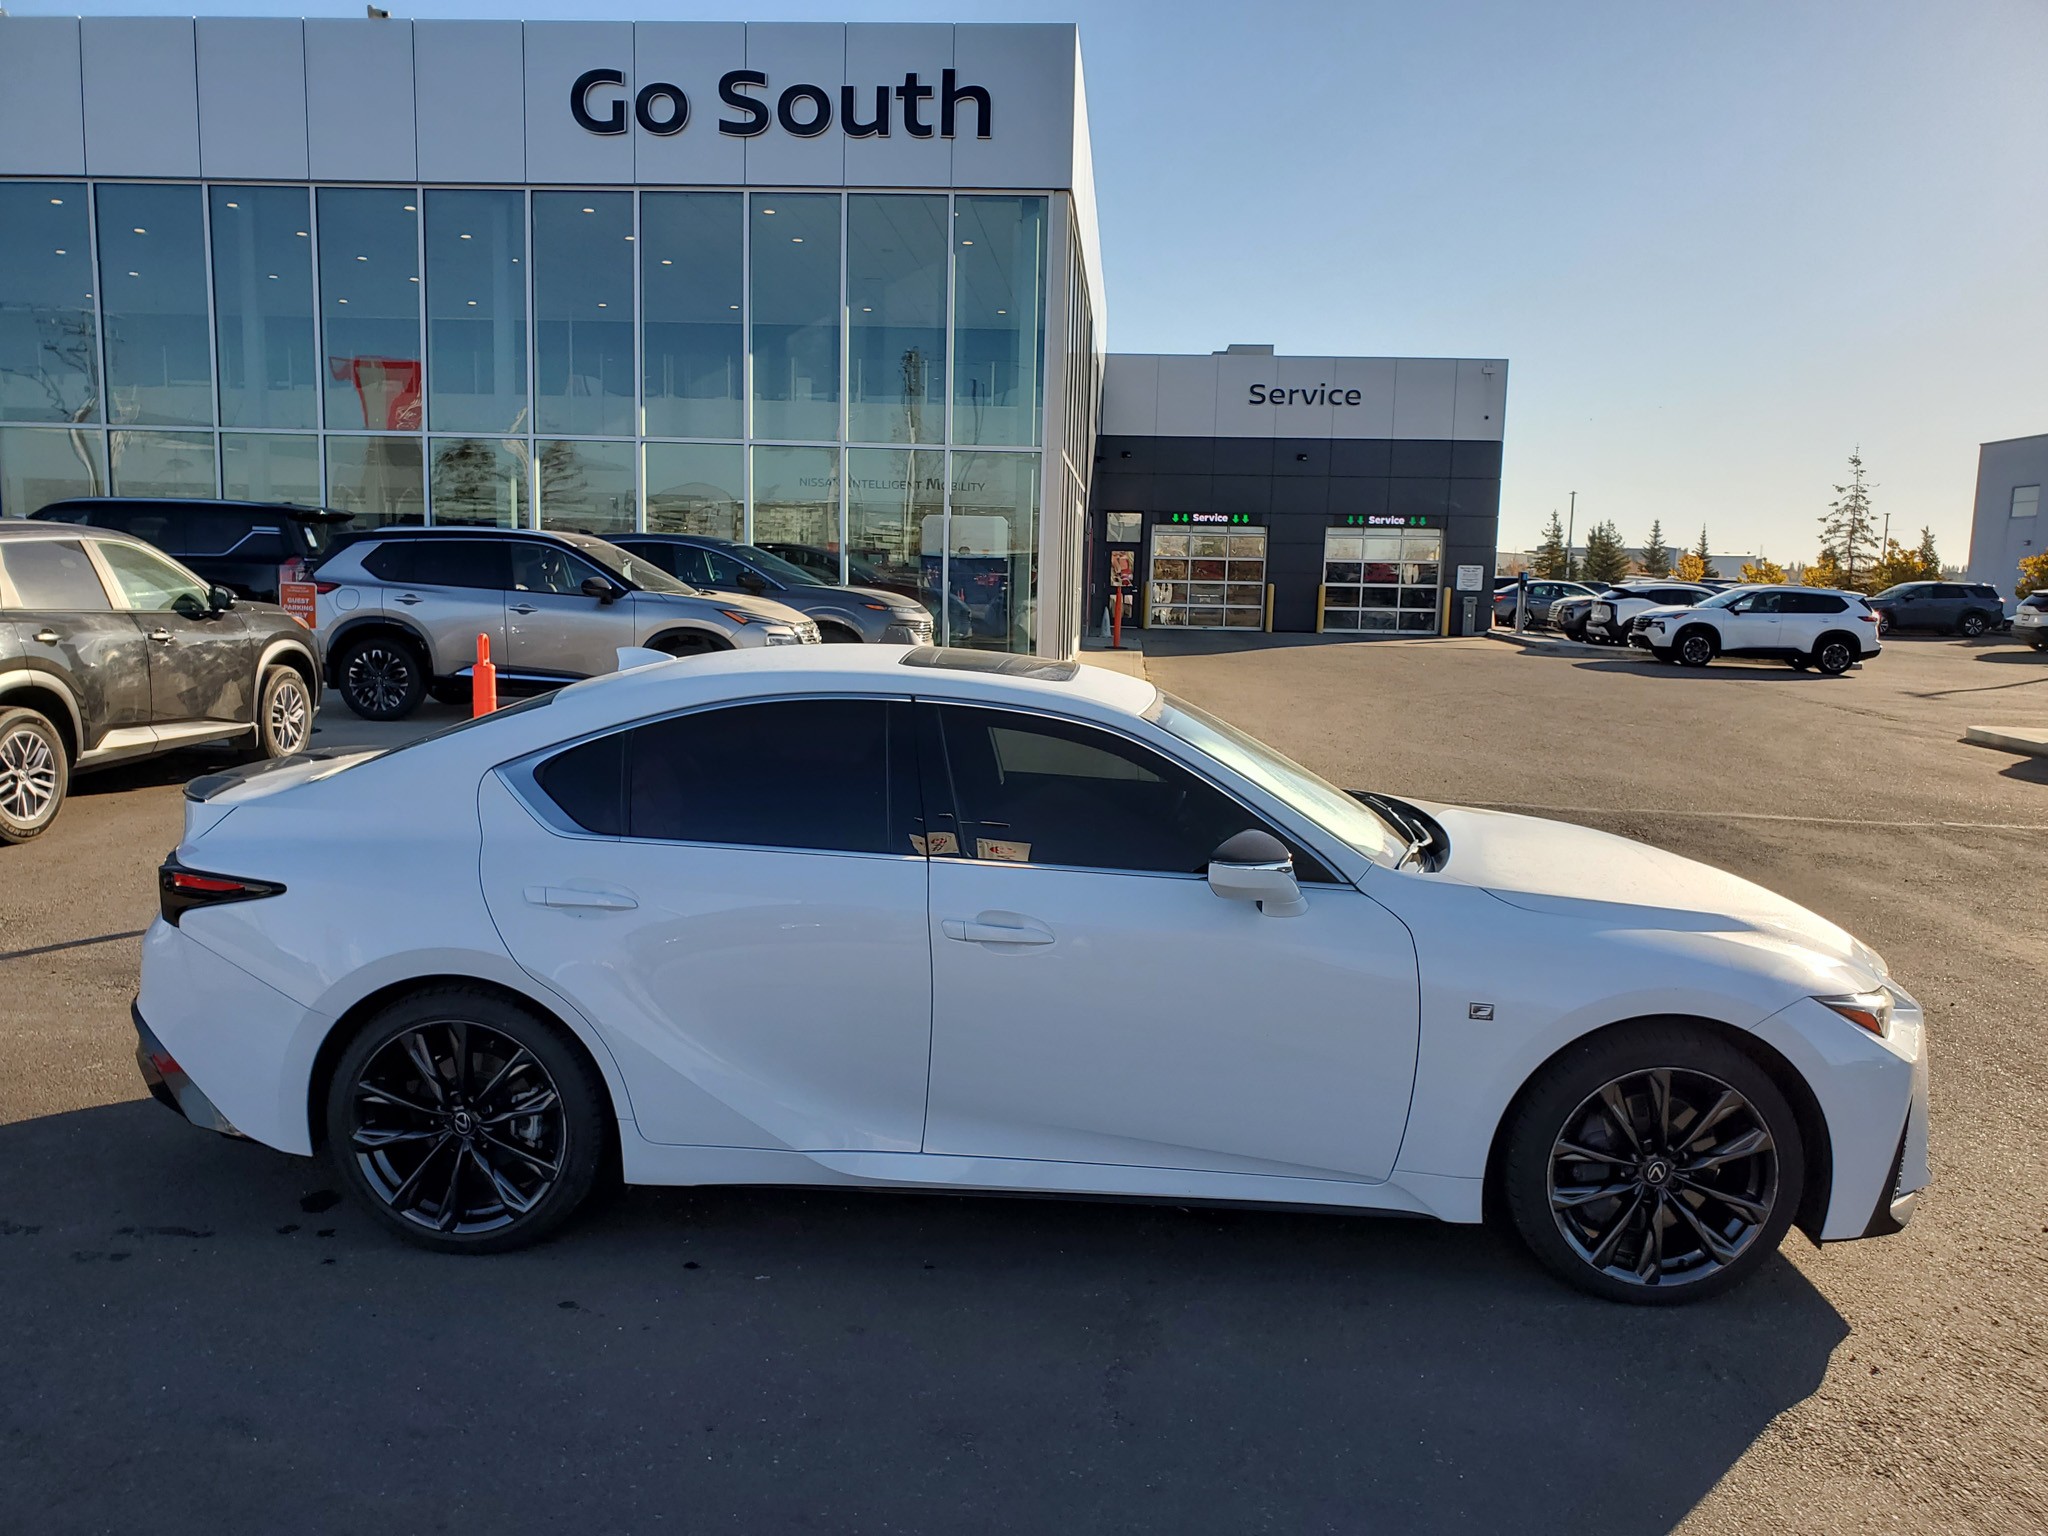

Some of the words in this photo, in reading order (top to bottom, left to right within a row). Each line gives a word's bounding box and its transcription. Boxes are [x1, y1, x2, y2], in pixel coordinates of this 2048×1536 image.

[569, 67, 691, 137] Go
[717, 67, 993, 140] South
[1248, 382, 1362, 407] Service
[1192, 512, 1229, 522] Service
[1368, 515, 1406, 525] Service
[287, 597, 310, 605] GUEST
[283, 603, 314, 612] PARKING
